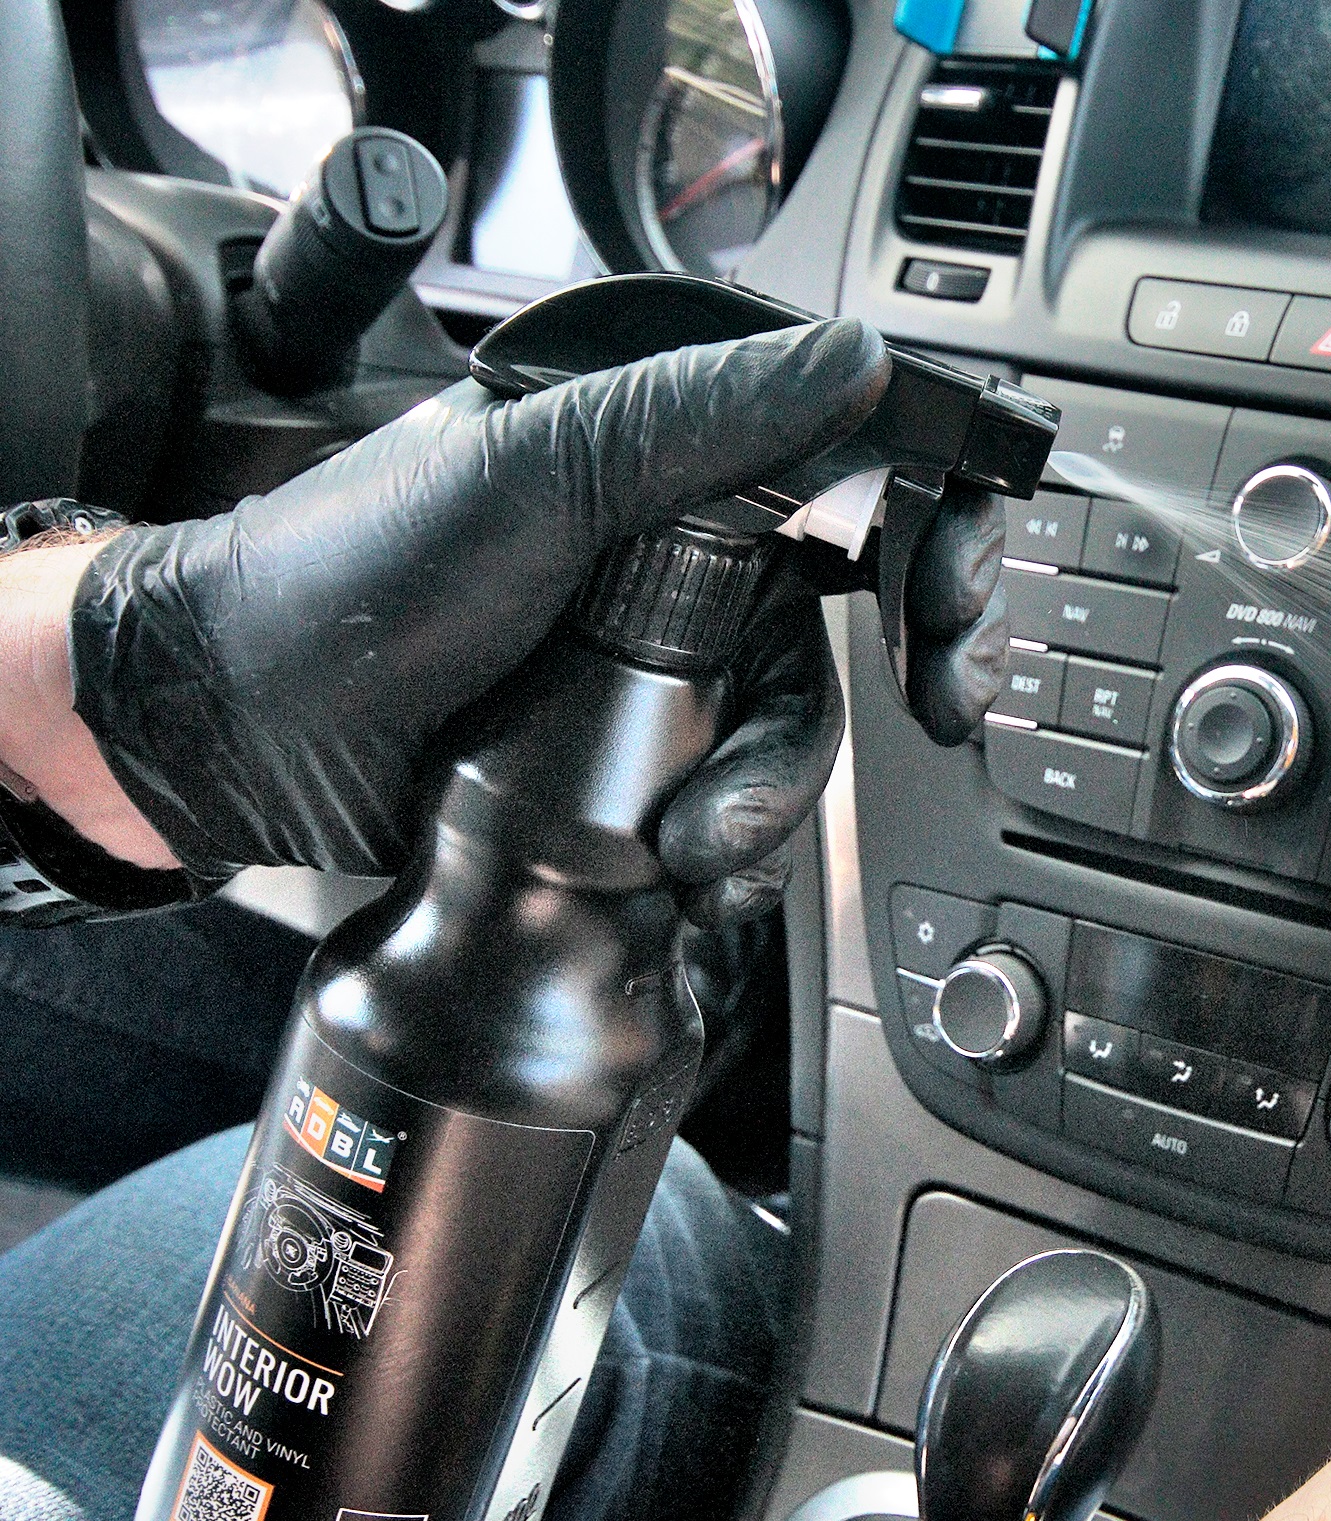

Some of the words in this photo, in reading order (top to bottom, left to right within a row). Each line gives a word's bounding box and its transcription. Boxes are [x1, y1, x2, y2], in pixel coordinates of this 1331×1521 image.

[1062, 604, 1090, 622] NAV
[1226, 603, 1258, 622] DVD
[1256, 609, 1284, 627] 800
[1283, 613, 1317, 633] NAVI
[1011, 675, 1041, 694] DEST
[1093, 688, 1119, 706] RPT
[1043, 768, 1077, 789] BACK
[1151, 1133, 1187, 1154] AUTO
[212, 1304, 335, 1416] INTERIOR
[203, 1338, 261, 1416] WOW
[234, 1420, 263, 1445] AND
[267, 1438, 311, 1470] VINYL
